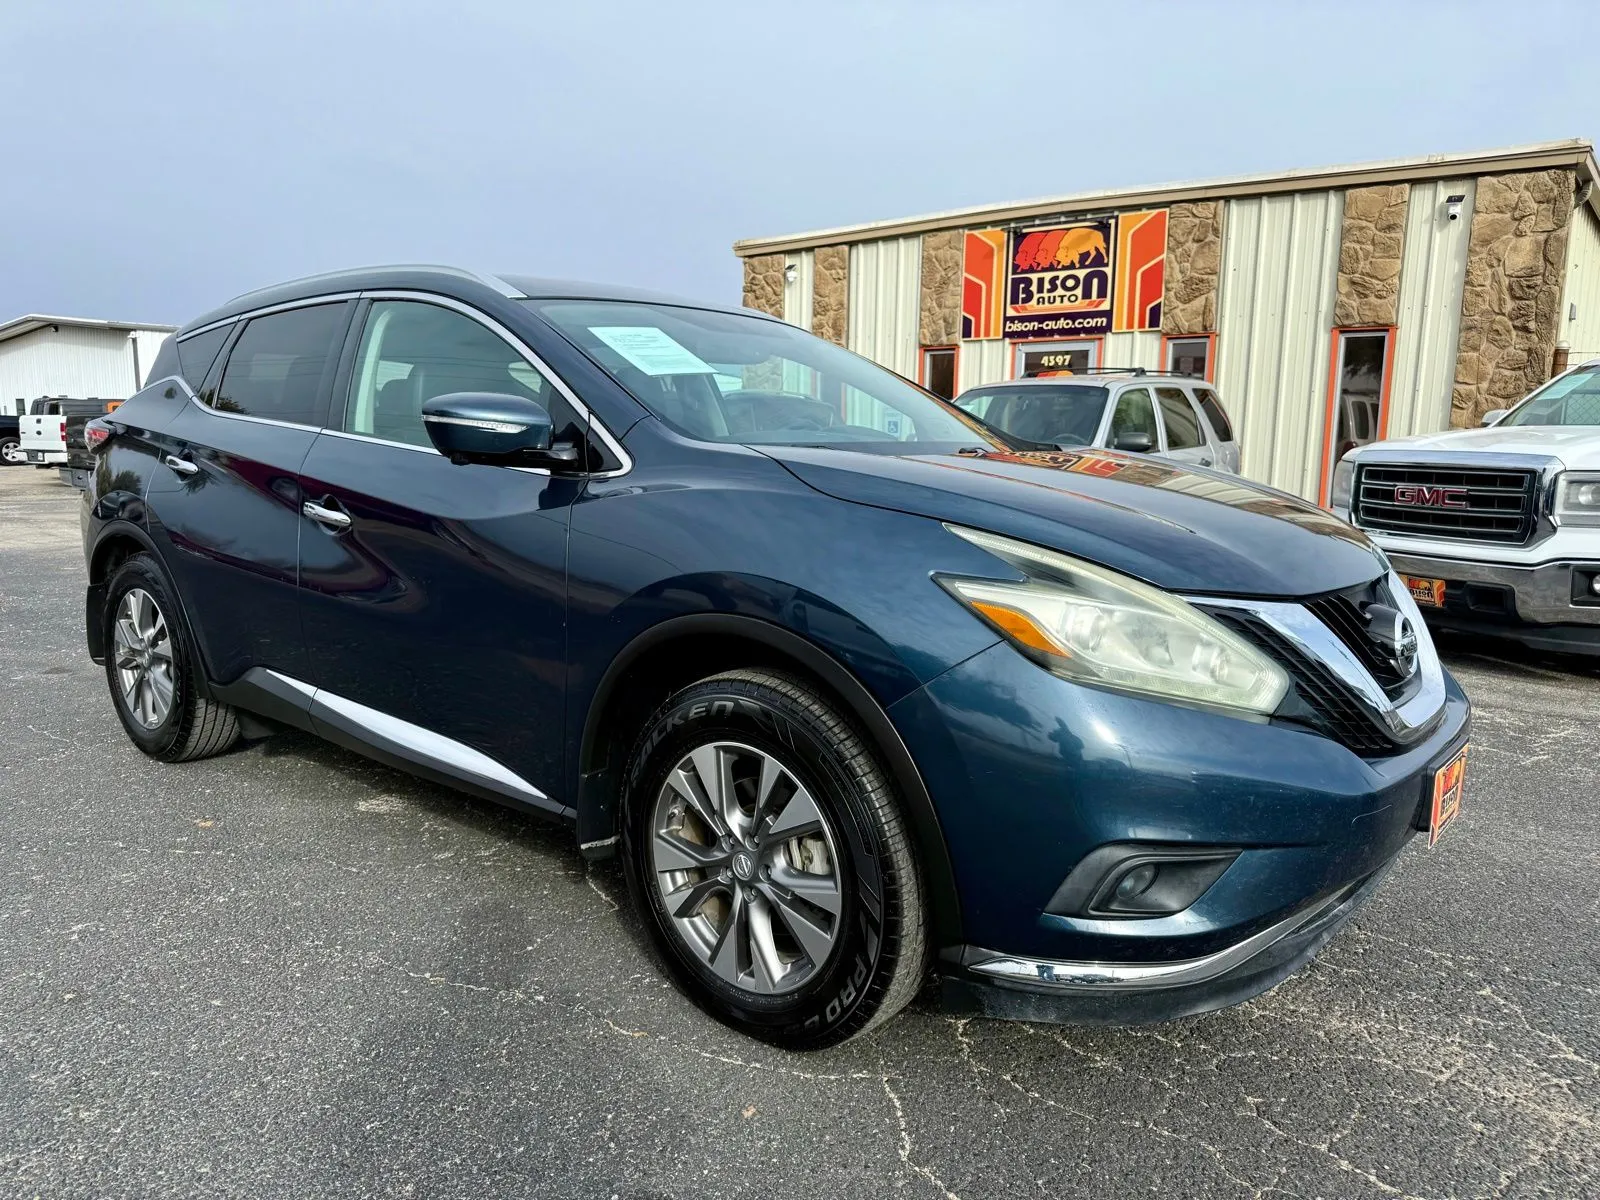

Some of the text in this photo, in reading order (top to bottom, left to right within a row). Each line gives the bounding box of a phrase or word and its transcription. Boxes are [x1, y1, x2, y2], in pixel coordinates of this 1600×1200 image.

[1010, 269, 1108, 305] BISON
[1036, 294, 1078, 305] AUTO
[1005, 317, 1107, 332] bison-auto.com
[1395, 486, 1468, 508] GMC
